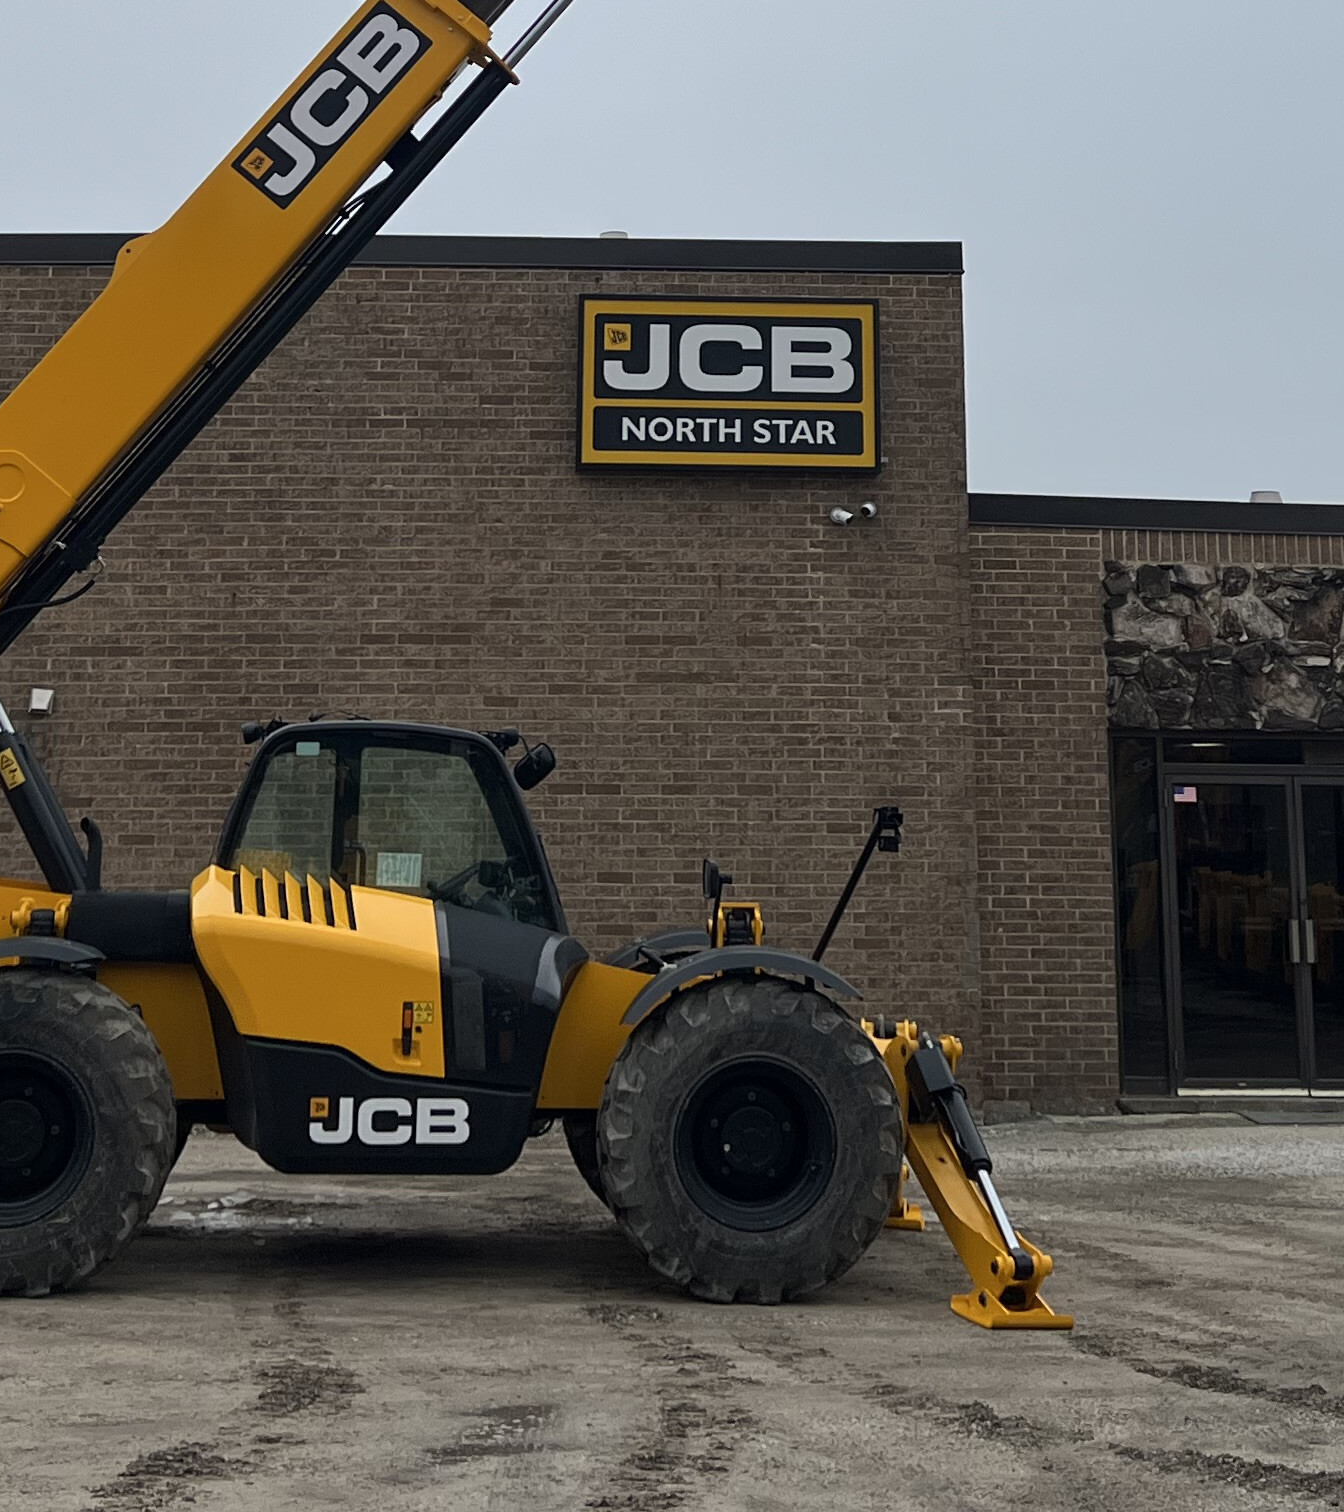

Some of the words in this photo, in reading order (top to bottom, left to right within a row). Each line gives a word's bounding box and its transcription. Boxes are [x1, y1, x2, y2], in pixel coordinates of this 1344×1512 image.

[263, 13, 422, 197] JCB
[603, 323, 856, 393] JCB
[621, 416, 742, 443] NORTH
[753, 418, 837, 445] STAR
[309, 1097, 471, 1145] JCB
